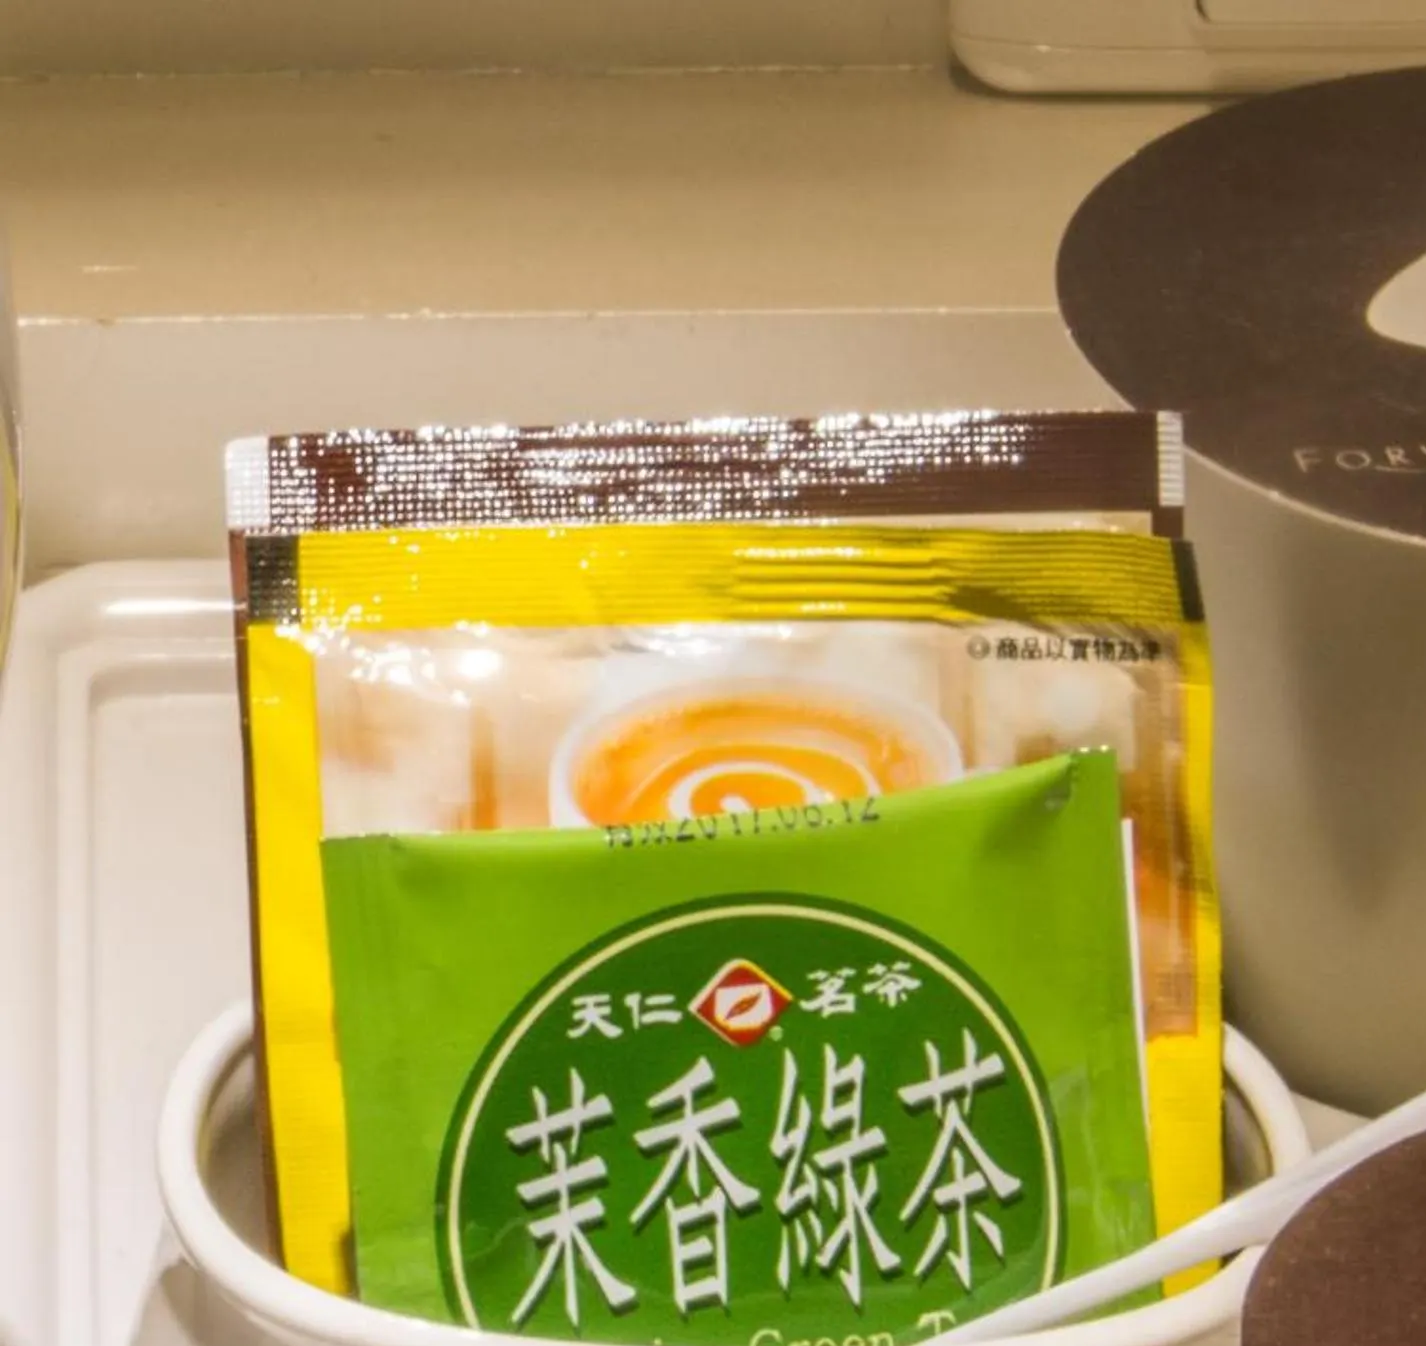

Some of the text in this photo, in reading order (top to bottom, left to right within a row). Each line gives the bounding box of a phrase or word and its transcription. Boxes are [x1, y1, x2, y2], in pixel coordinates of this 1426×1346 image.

[568, 962, 922, 1038] 天仁 茗茶
[505, 1028, 1022, 1327] 茉香綠茶
